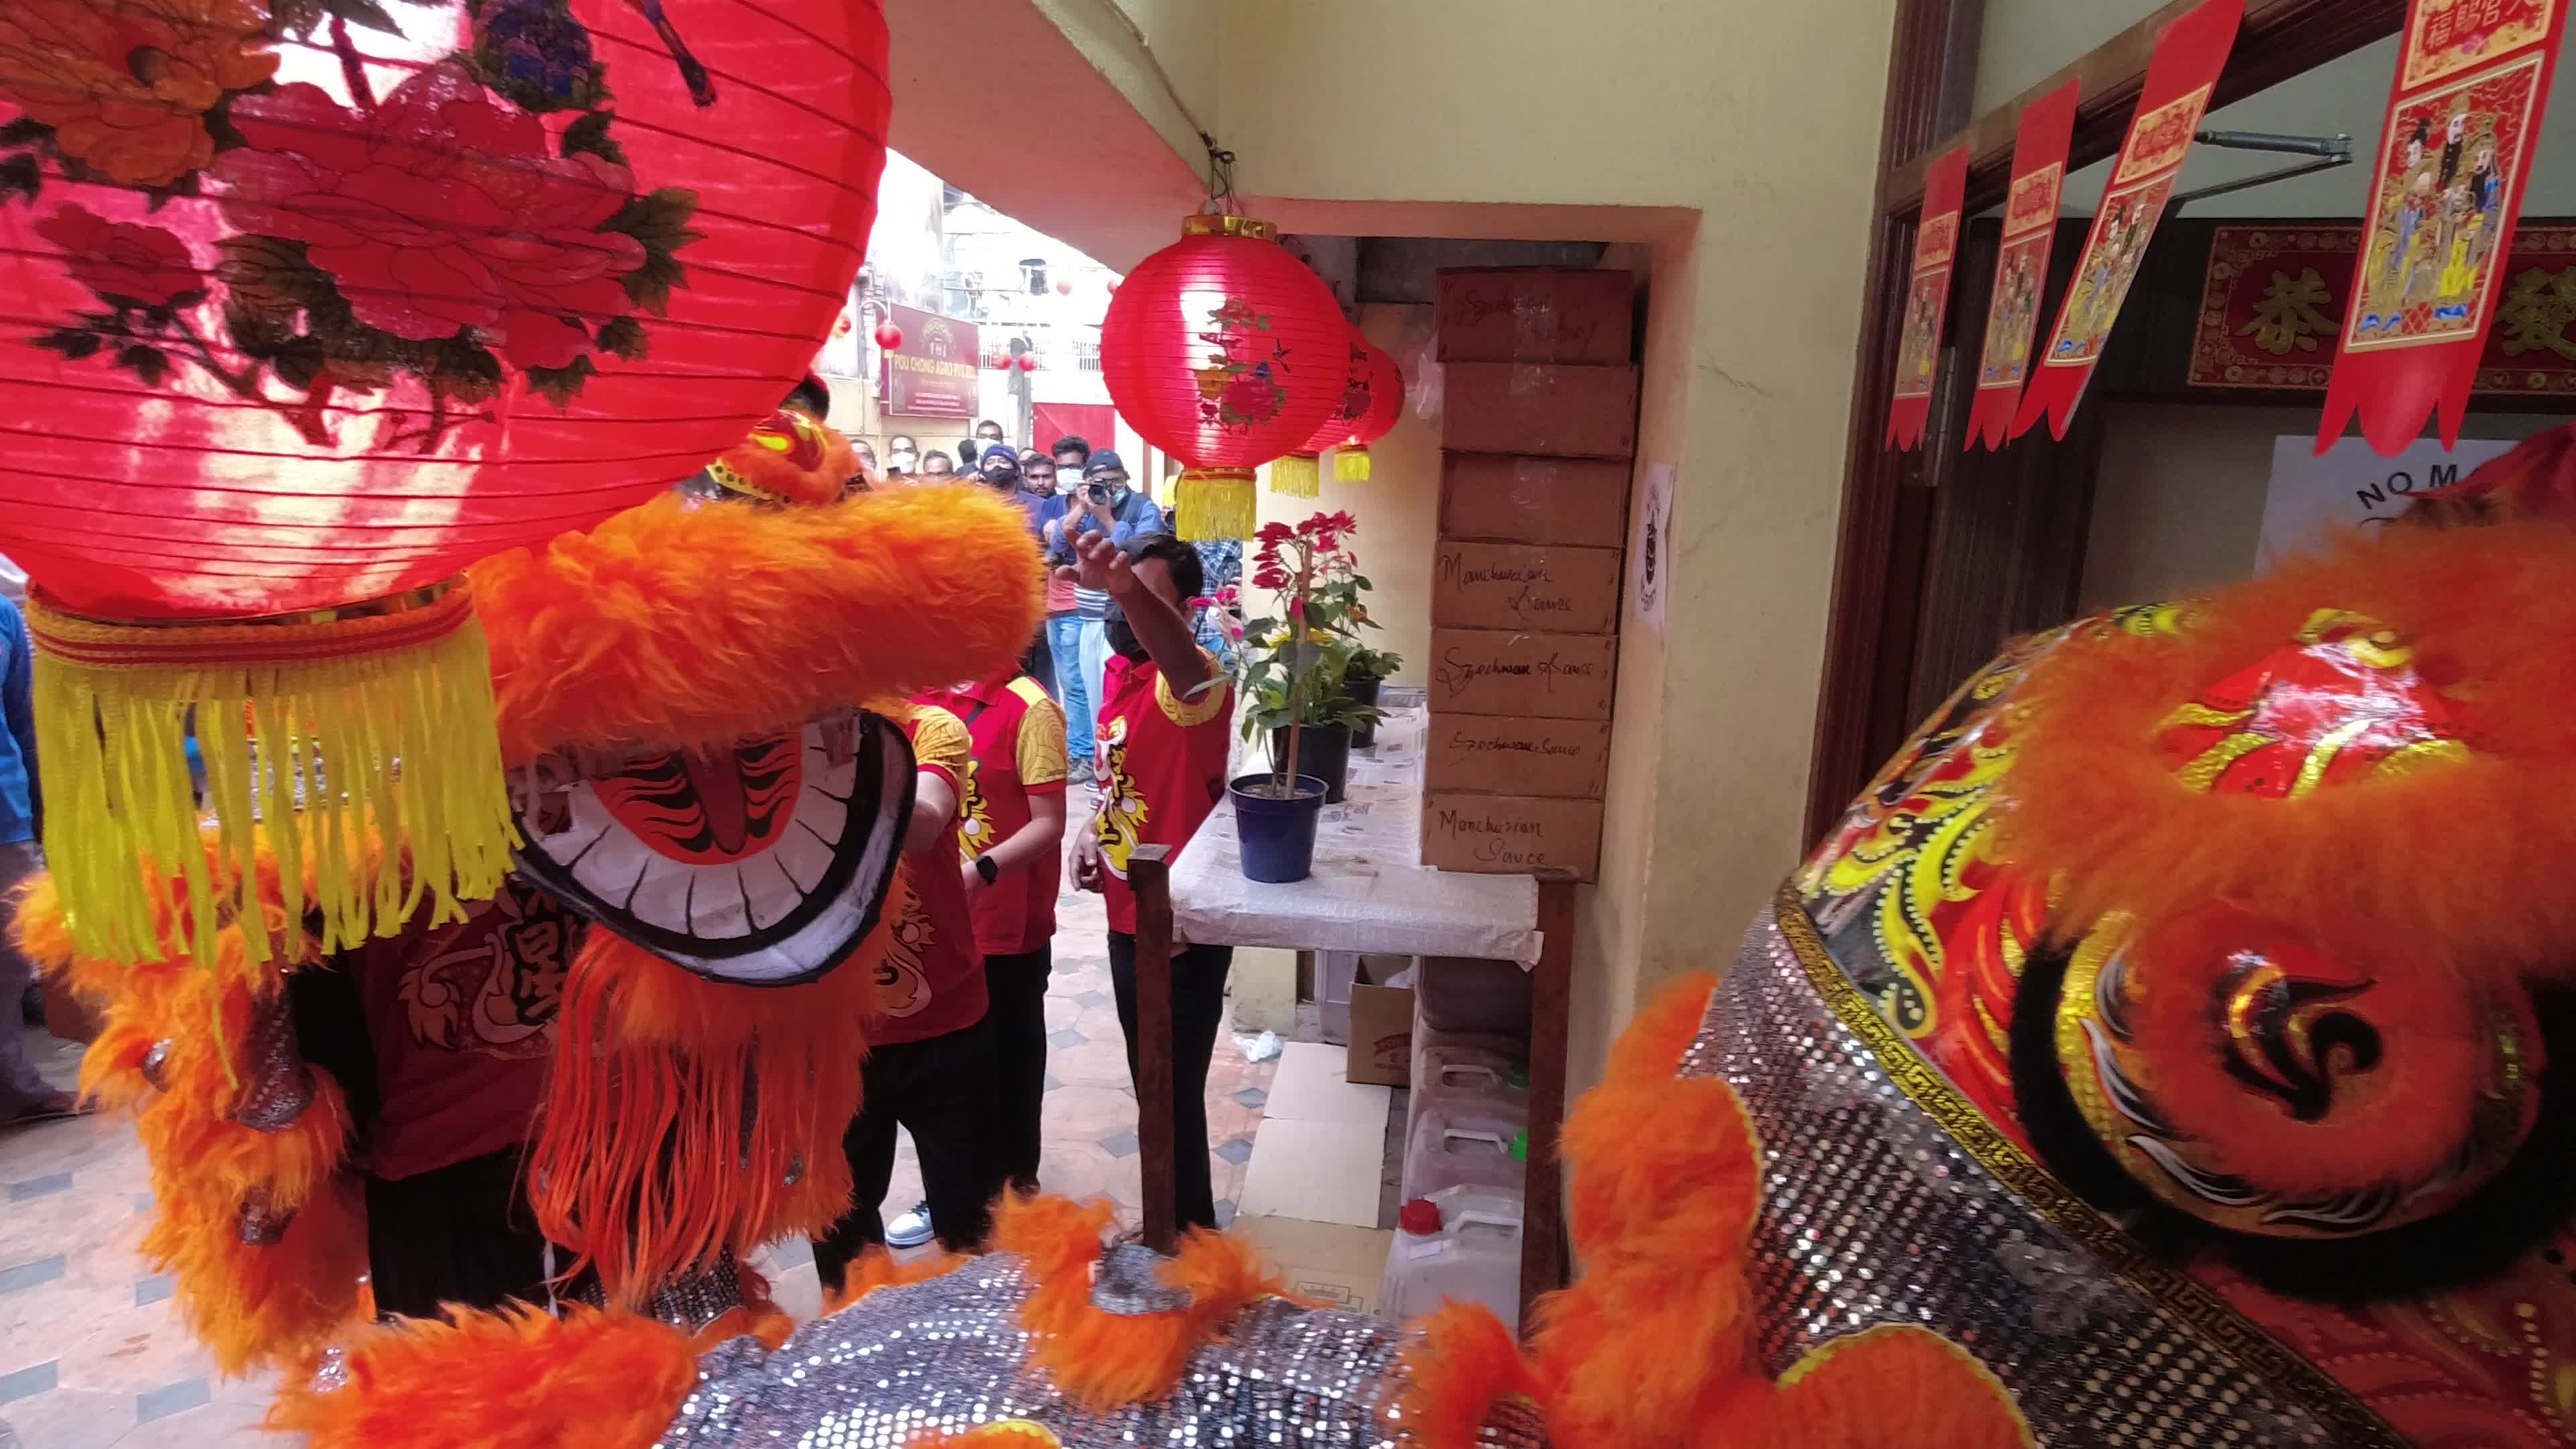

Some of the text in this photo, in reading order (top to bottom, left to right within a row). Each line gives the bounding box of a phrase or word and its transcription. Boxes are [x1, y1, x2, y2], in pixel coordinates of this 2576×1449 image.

[2357, 472, 2413, 510] NO
[1439, 810, 1544, 840] Manchurian
[1474, 838, 1547, 865] Sauce
